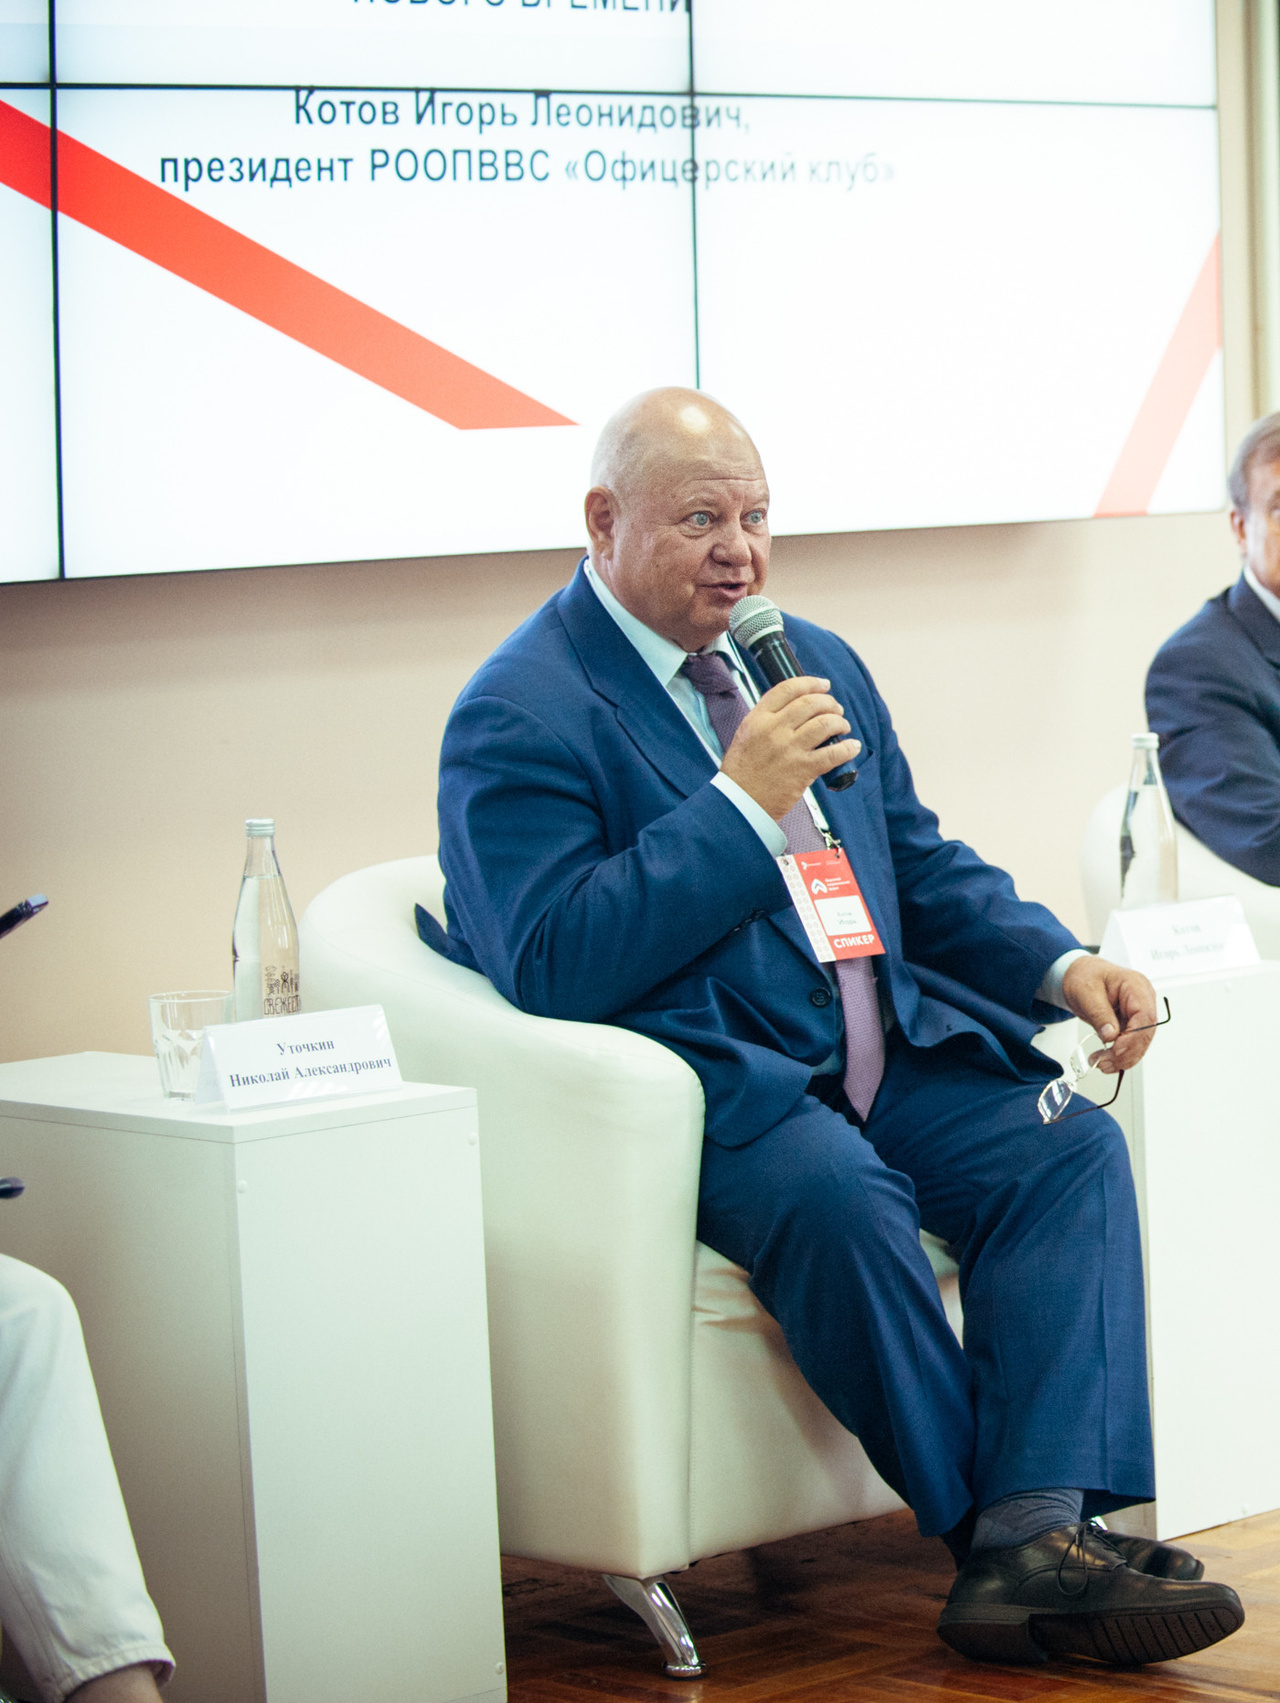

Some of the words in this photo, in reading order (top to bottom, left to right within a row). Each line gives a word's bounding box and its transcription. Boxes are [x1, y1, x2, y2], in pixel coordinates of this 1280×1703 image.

[294, 88, 400, 125] Котов
[414, 89, 518, 135] Игорь
[530, 92, 751, 134] Леонидович,
[160, 156, 354, 192] президент
[370, 148, 551, 182] РООПВВС
[564, 150, 797, 191] «Офицерский
[808, 152, 896, 192] клуб»
[833, 934, 875, 949] СПИКЕР
[276, 1040, 335, 1056] Уточкин
[229, 1067, 290, 1088] Николай
[294, 1057, 392, 1079] Александрович
